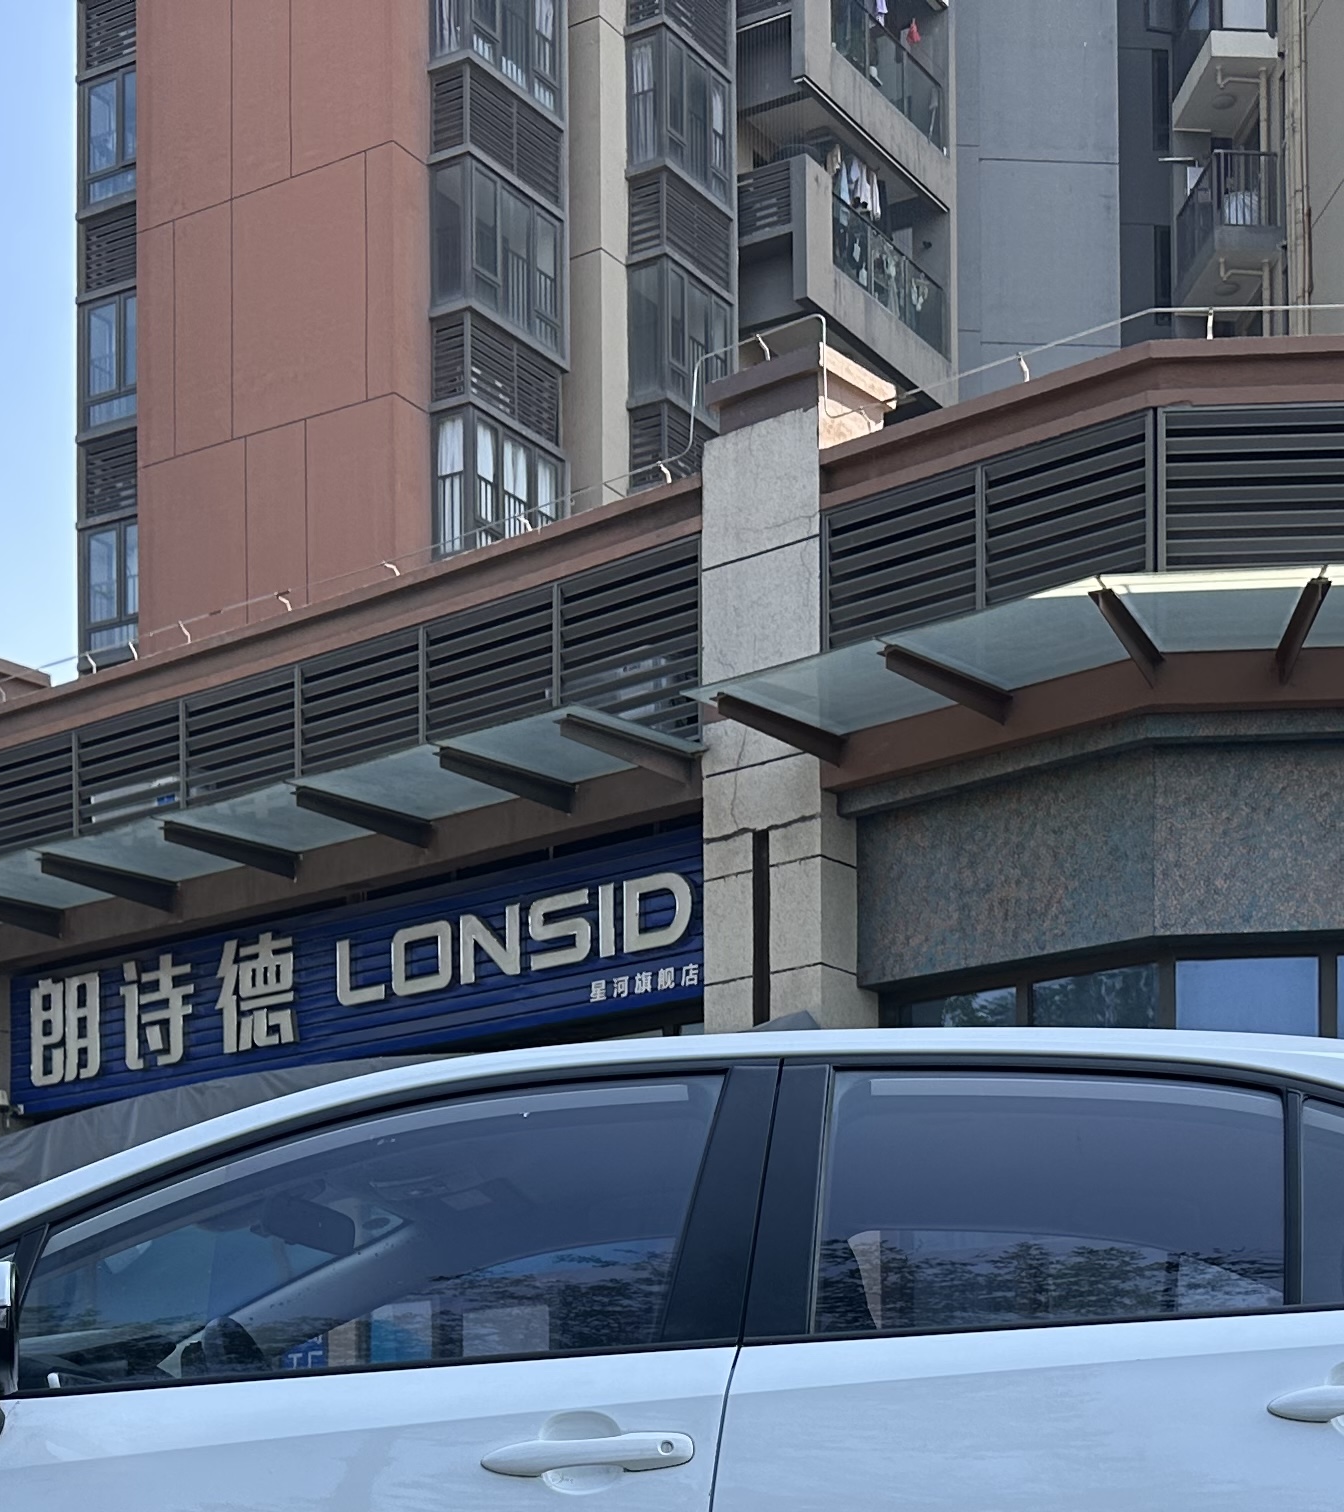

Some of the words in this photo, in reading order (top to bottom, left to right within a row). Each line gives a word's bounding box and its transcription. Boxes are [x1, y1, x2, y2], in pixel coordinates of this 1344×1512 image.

[30, 932, 295, 1088] 朗诗德
[336, 872, 692, 1006] LONSID
[589, 963, 699, 1003] 星河旗舰店
